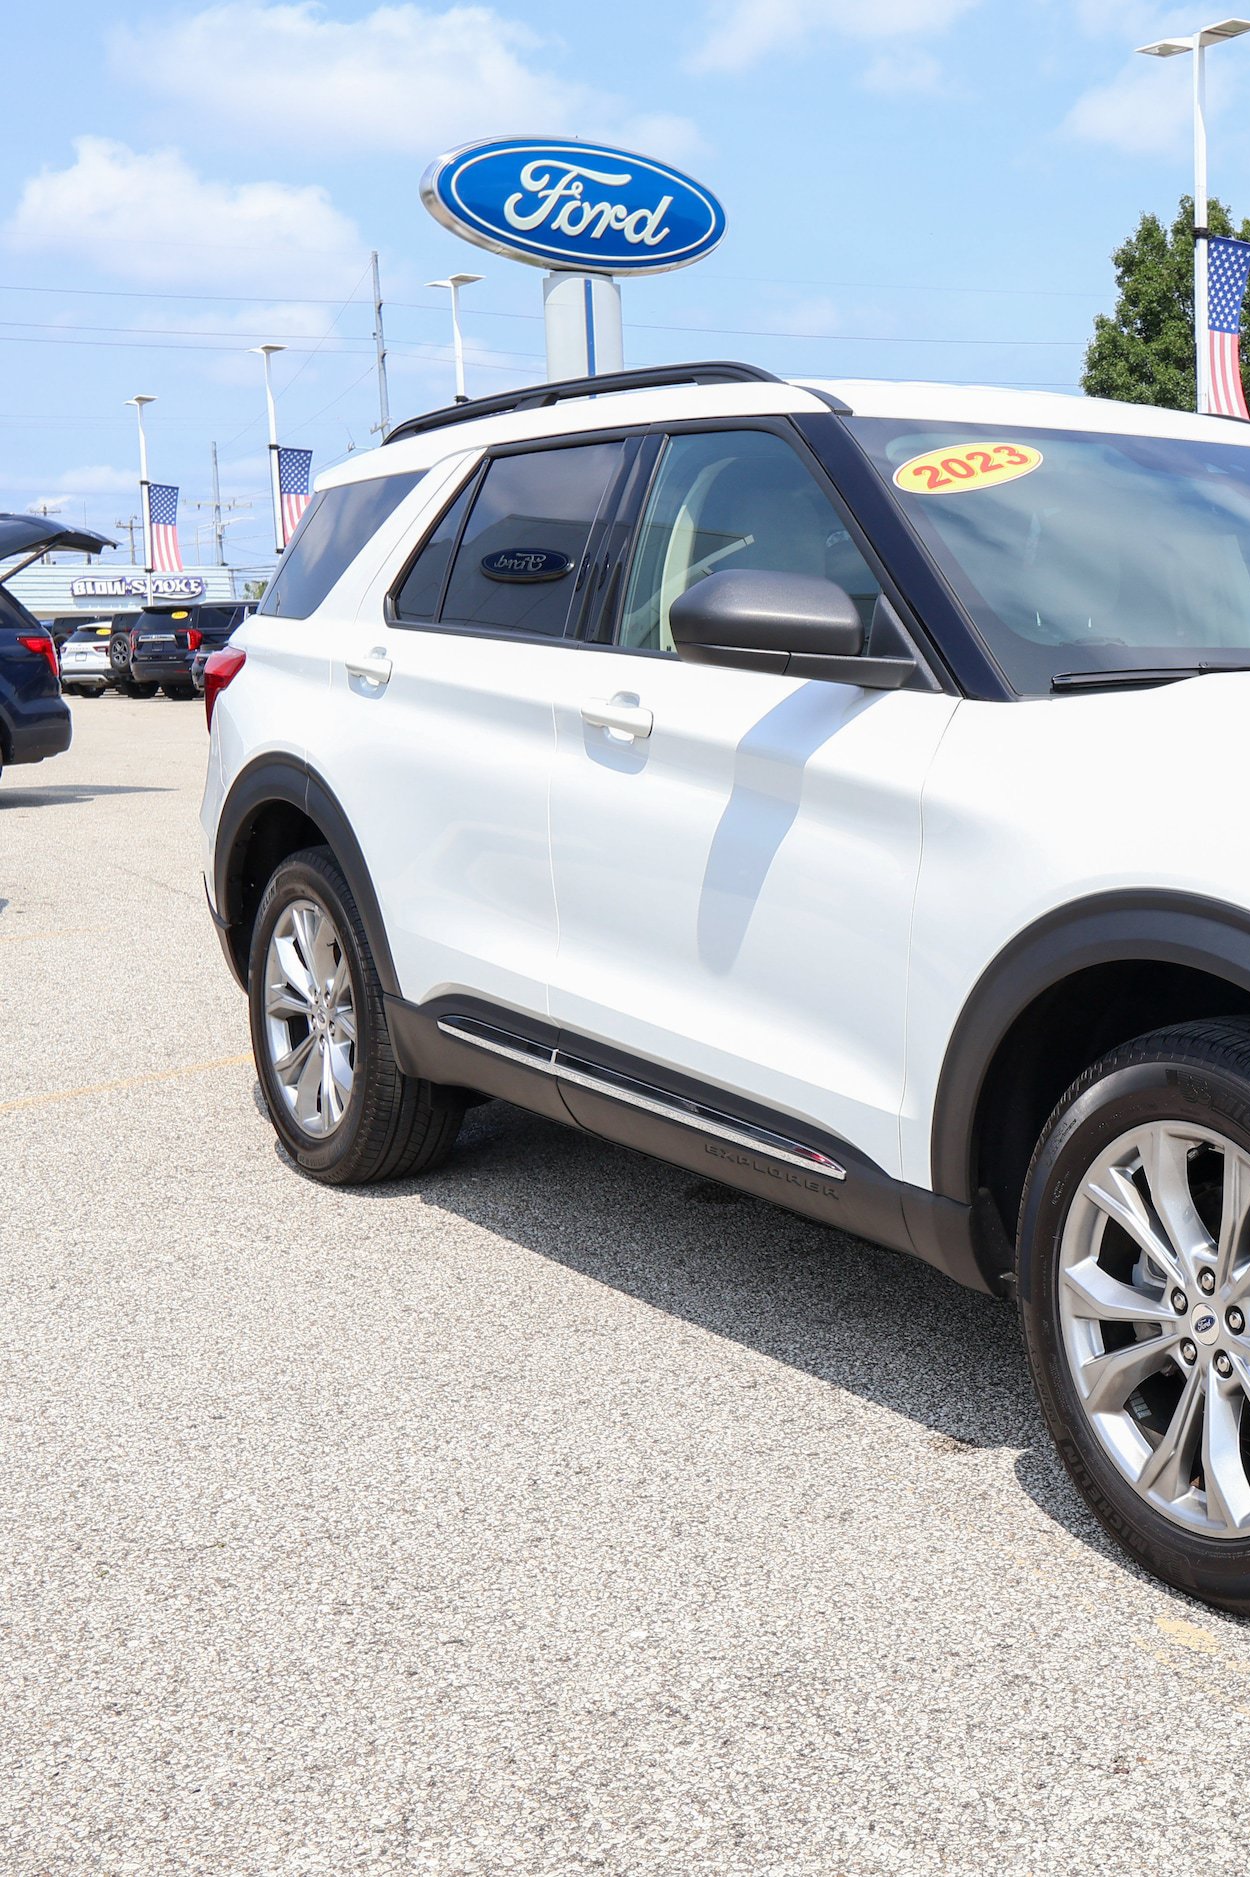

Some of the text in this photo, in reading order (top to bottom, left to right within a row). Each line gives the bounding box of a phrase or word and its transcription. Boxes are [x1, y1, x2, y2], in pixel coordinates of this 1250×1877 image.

[504, 159, 674, 247] Ford
[912, 446, 1029, 491] 2023
[73, 579, 126, 596] BLOW
[131, 578, 202, 597] SMOKE
[704, 1144, 840, 1200] EXPLORER
[1197, 1318, 1211, 1331] Ford
[1062, 1442, 1150, 1555] MICHELIN
